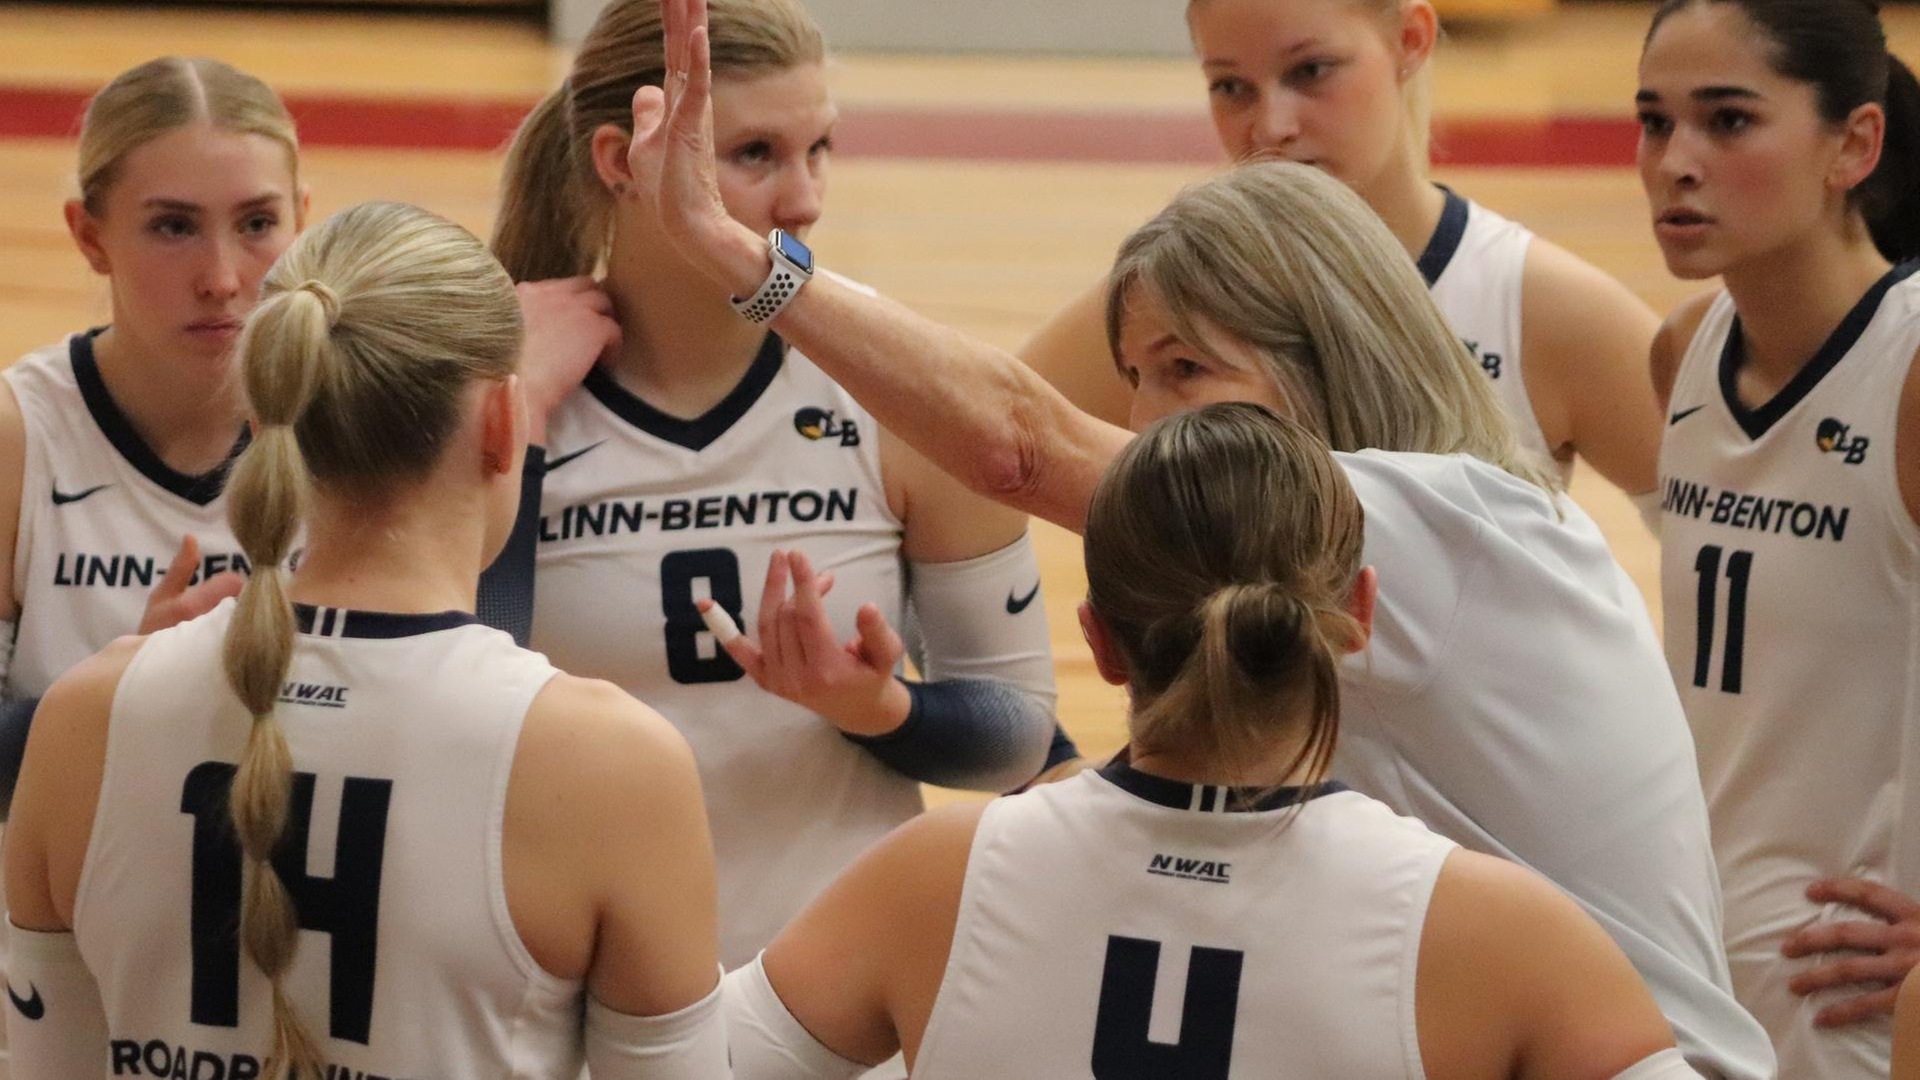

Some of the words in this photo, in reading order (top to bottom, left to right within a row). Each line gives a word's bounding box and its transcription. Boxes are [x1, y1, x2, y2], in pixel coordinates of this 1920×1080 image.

[539, 488, 858, 543] LINN-BENTON
[660, 547, 746, 684] 8
[1693, 544, 1753, 694] 11
[180, 760, 393, 1045] 14
[1149, 853, 1232, 878] NWAC
